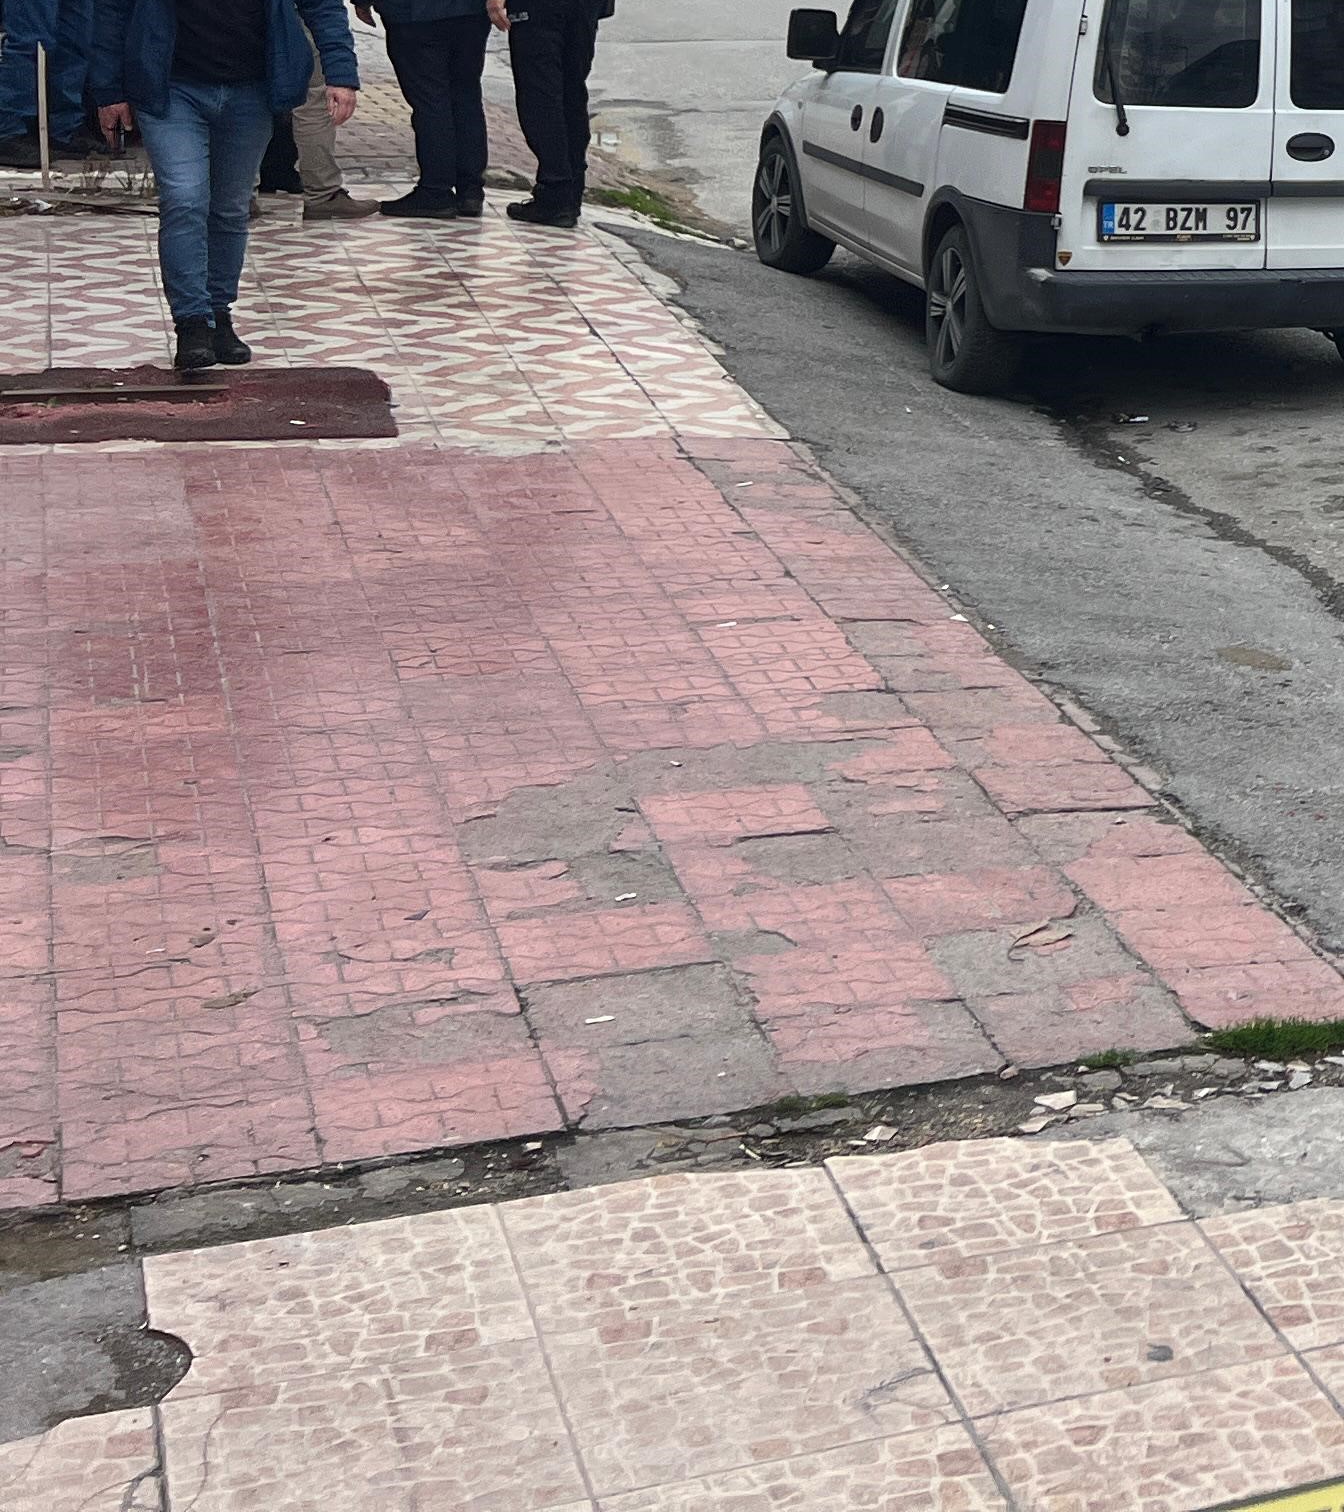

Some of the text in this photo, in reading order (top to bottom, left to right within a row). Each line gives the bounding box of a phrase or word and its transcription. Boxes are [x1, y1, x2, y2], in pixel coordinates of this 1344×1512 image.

[1102, 206, 1253, 231] TR 42 BZM 97
